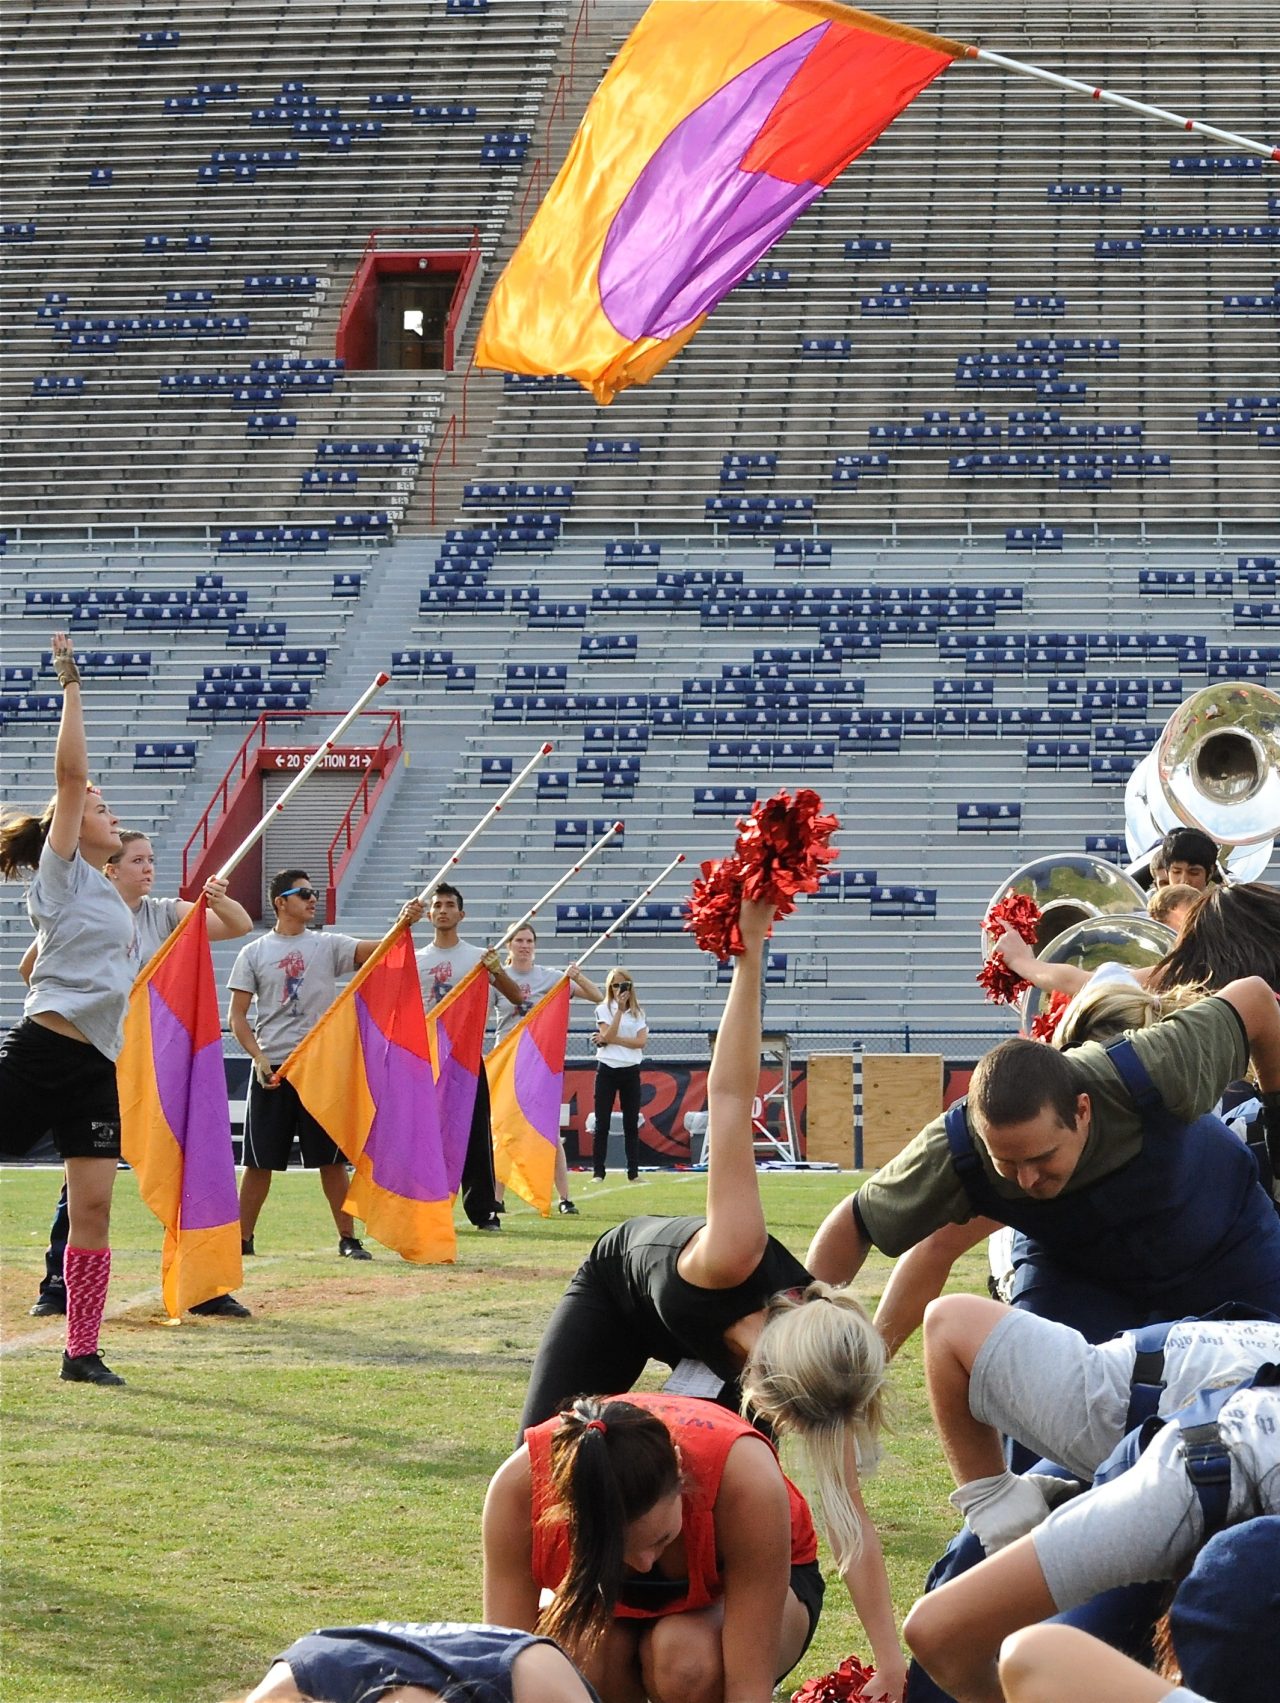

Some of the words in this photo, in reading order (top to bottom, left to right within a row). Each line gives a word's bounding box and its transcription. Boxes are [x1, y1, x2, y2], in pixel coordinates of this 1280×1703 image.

[286, 754, 300, 768] 20
[303, 754, 346, 768] SCTION
[349, 754, 360, 768] 21
